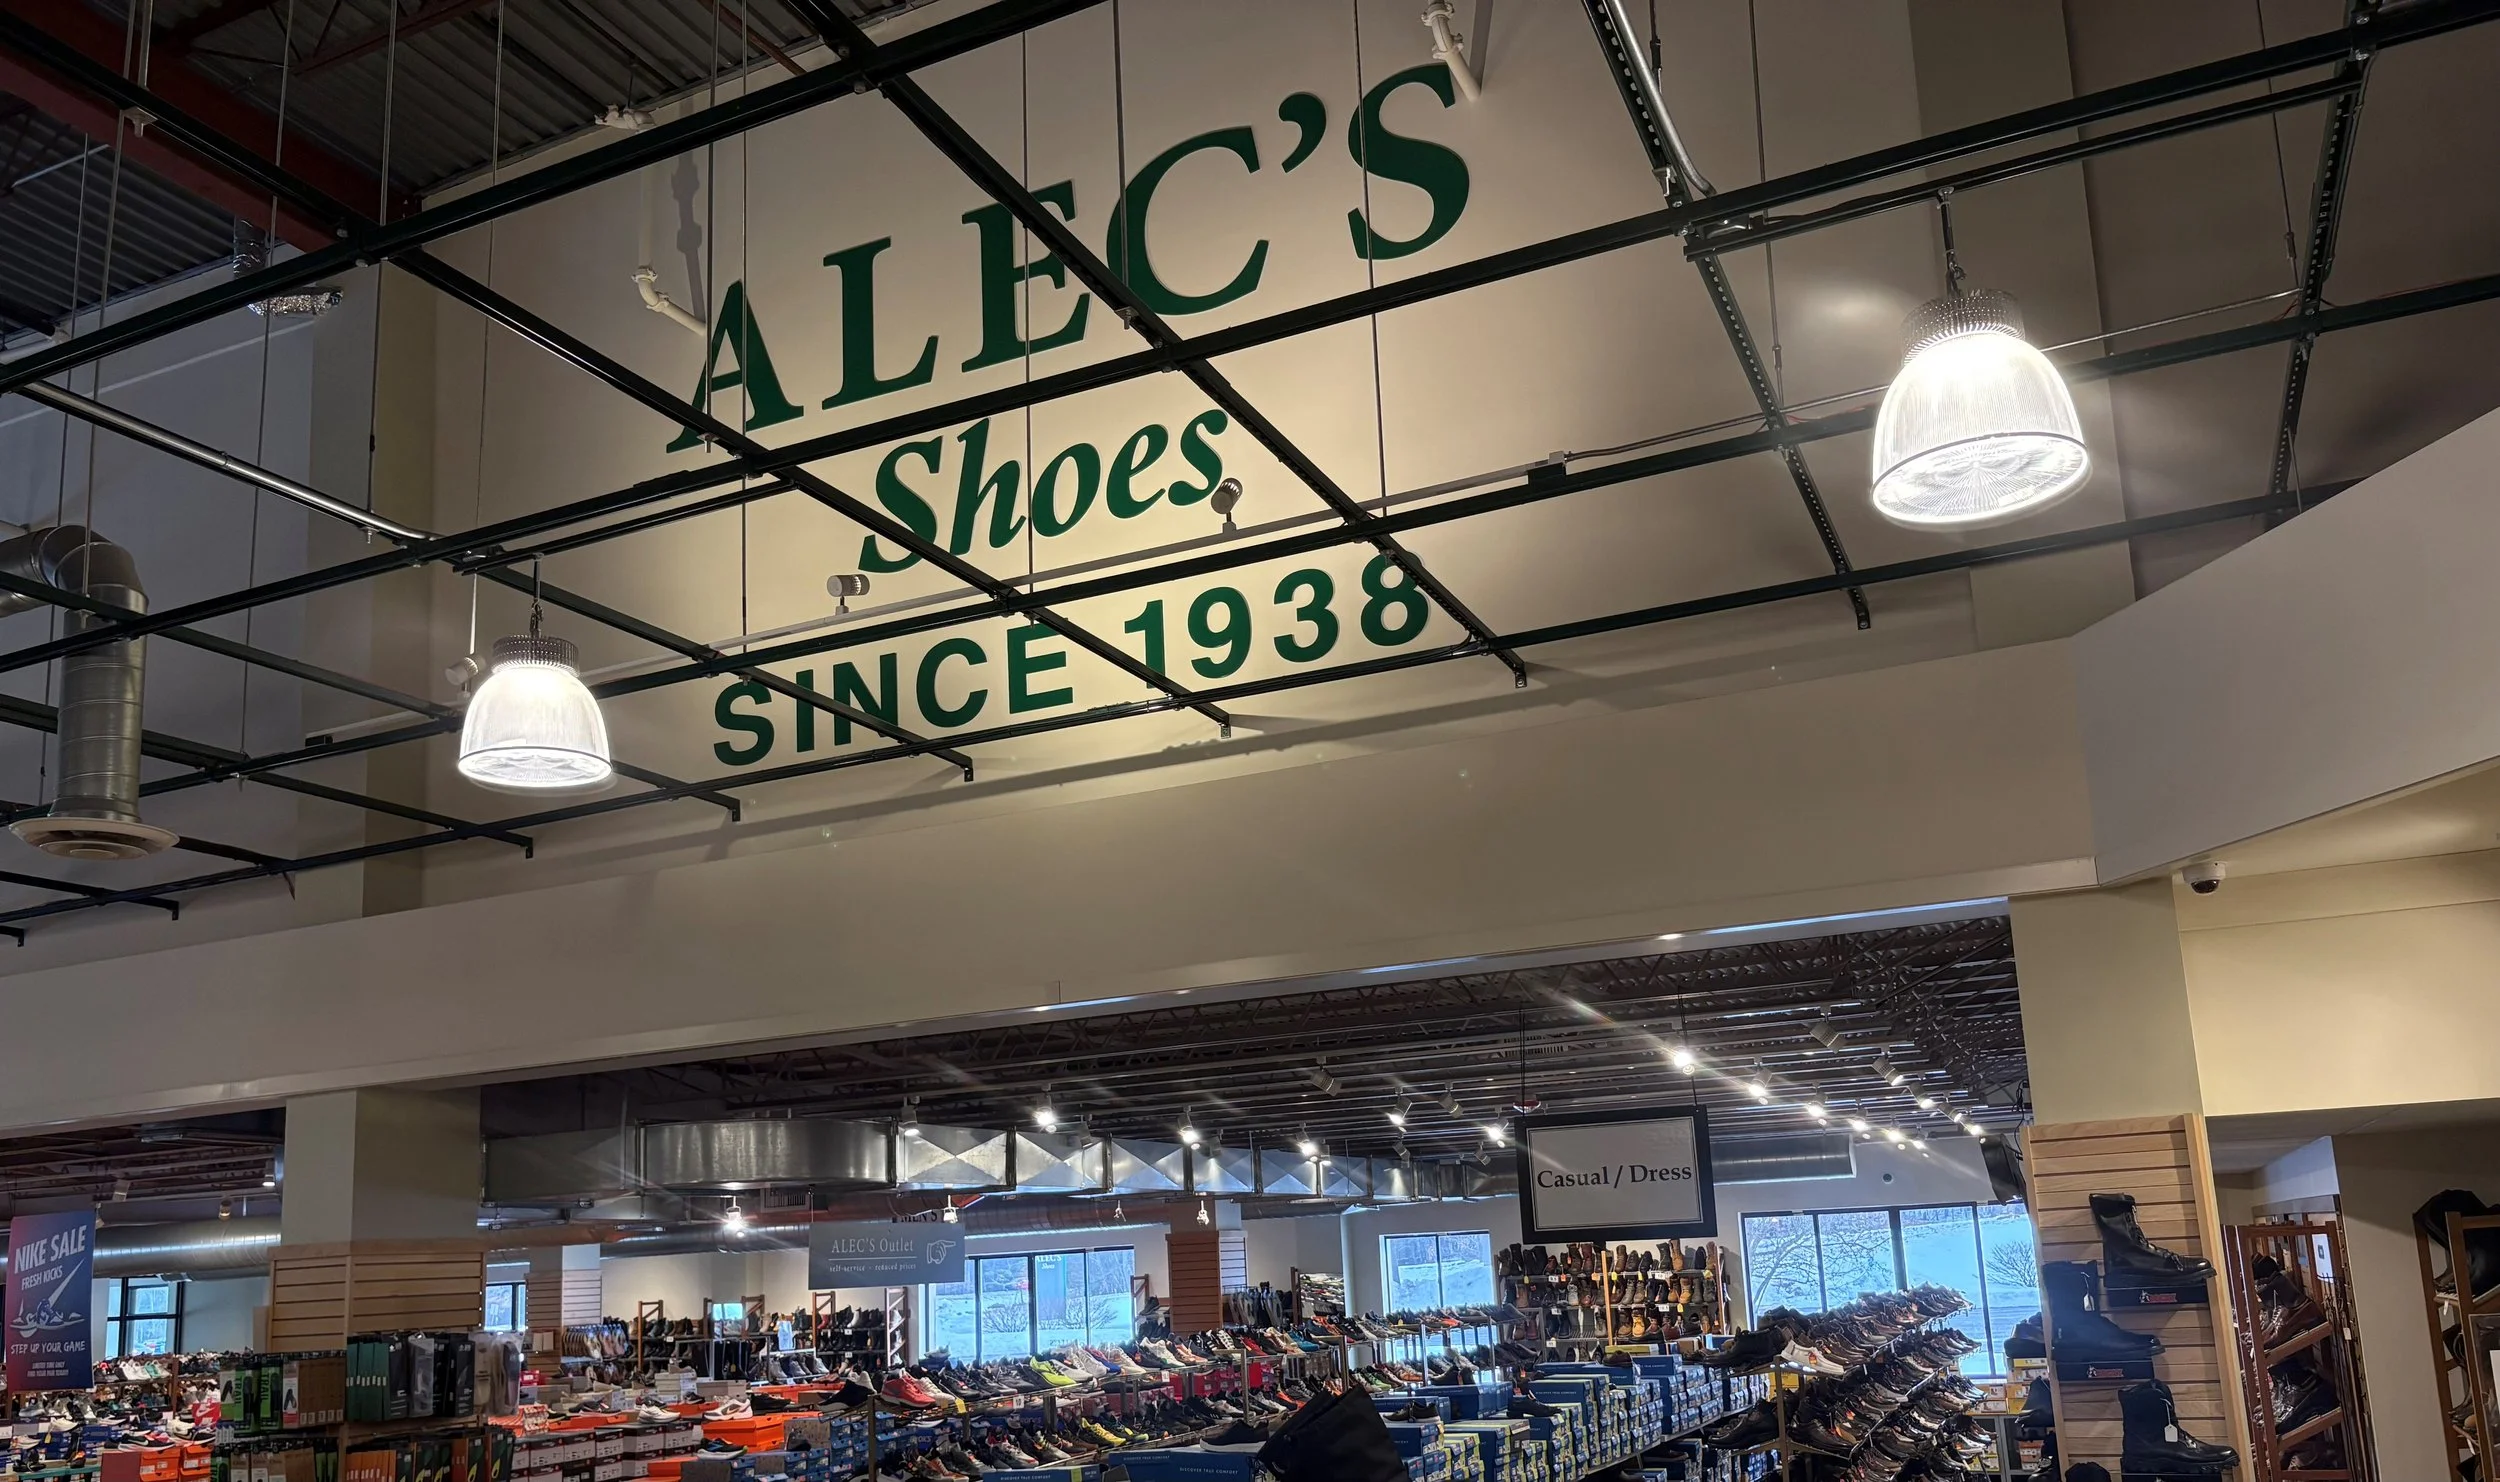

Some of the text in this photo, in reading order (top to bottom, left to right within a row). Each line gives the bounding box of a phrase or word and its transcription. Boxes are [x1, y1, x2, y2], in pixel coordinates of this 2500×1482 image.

[666, 63, 1471, 454] ALEC'S
[858, 408, 1229, 575] Shoes
[714, 552, 1431, 767] SINCE 1938
[1537, 1166, 1610, 1189] Casual
[1629, 1164, 1692, 1184] Dress
[14, 1225, 87, 1274] NIKE SALE
[831, 1238, 914, 1253] ALEC'S Outlet
[22, 1265, 63, 1290] FRESH KICKS
[11, 1340, 86, 1355] STEP UP YOUR GAME
